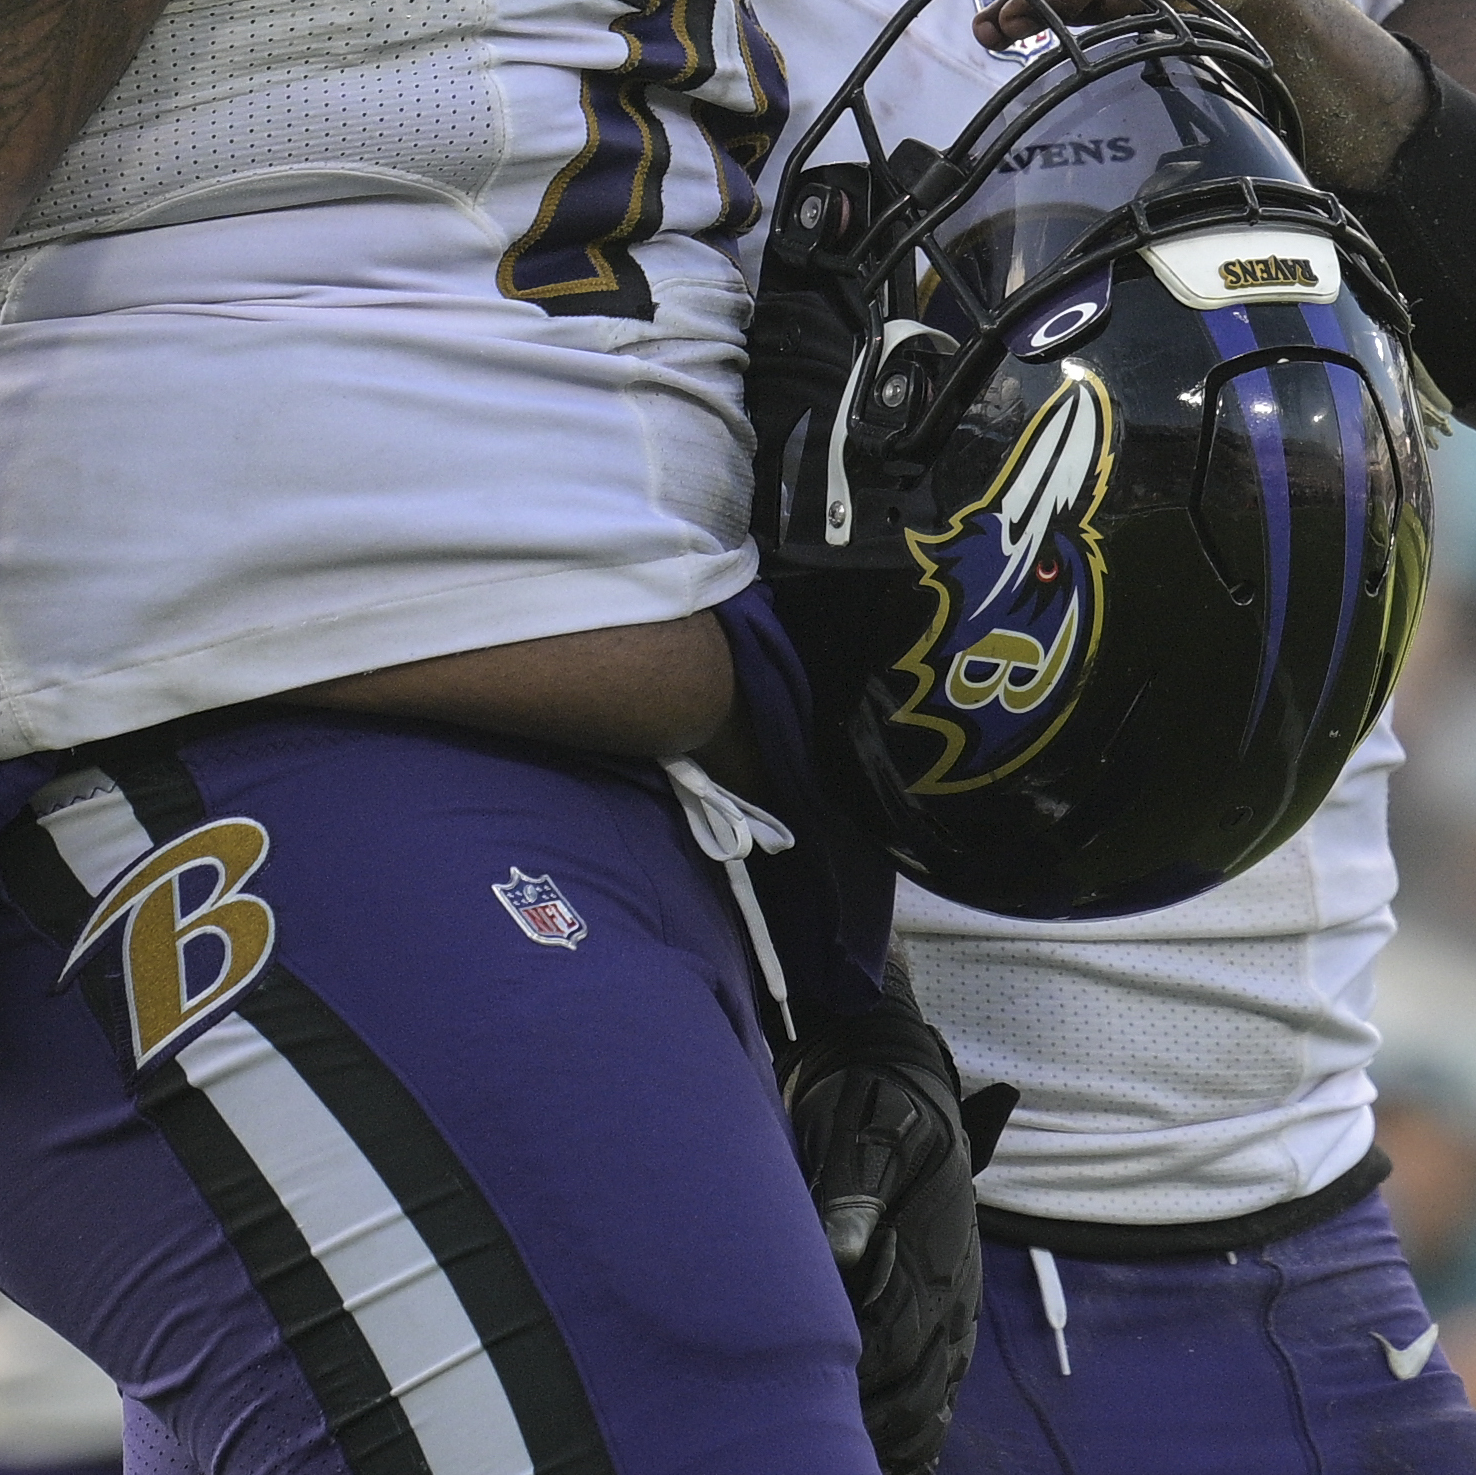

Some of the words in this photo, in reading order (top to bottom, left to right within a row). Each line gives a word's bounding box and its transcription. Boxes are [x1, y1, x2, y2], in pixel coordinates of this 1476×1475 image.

[998, 136, 1136, 174] VENS
[1220, 255, 1319, 289] RAVENS
[945, 587, 1078, 714] B
[522, 903, 578, 934] NFL
[57, 817, 276, 1070] B
